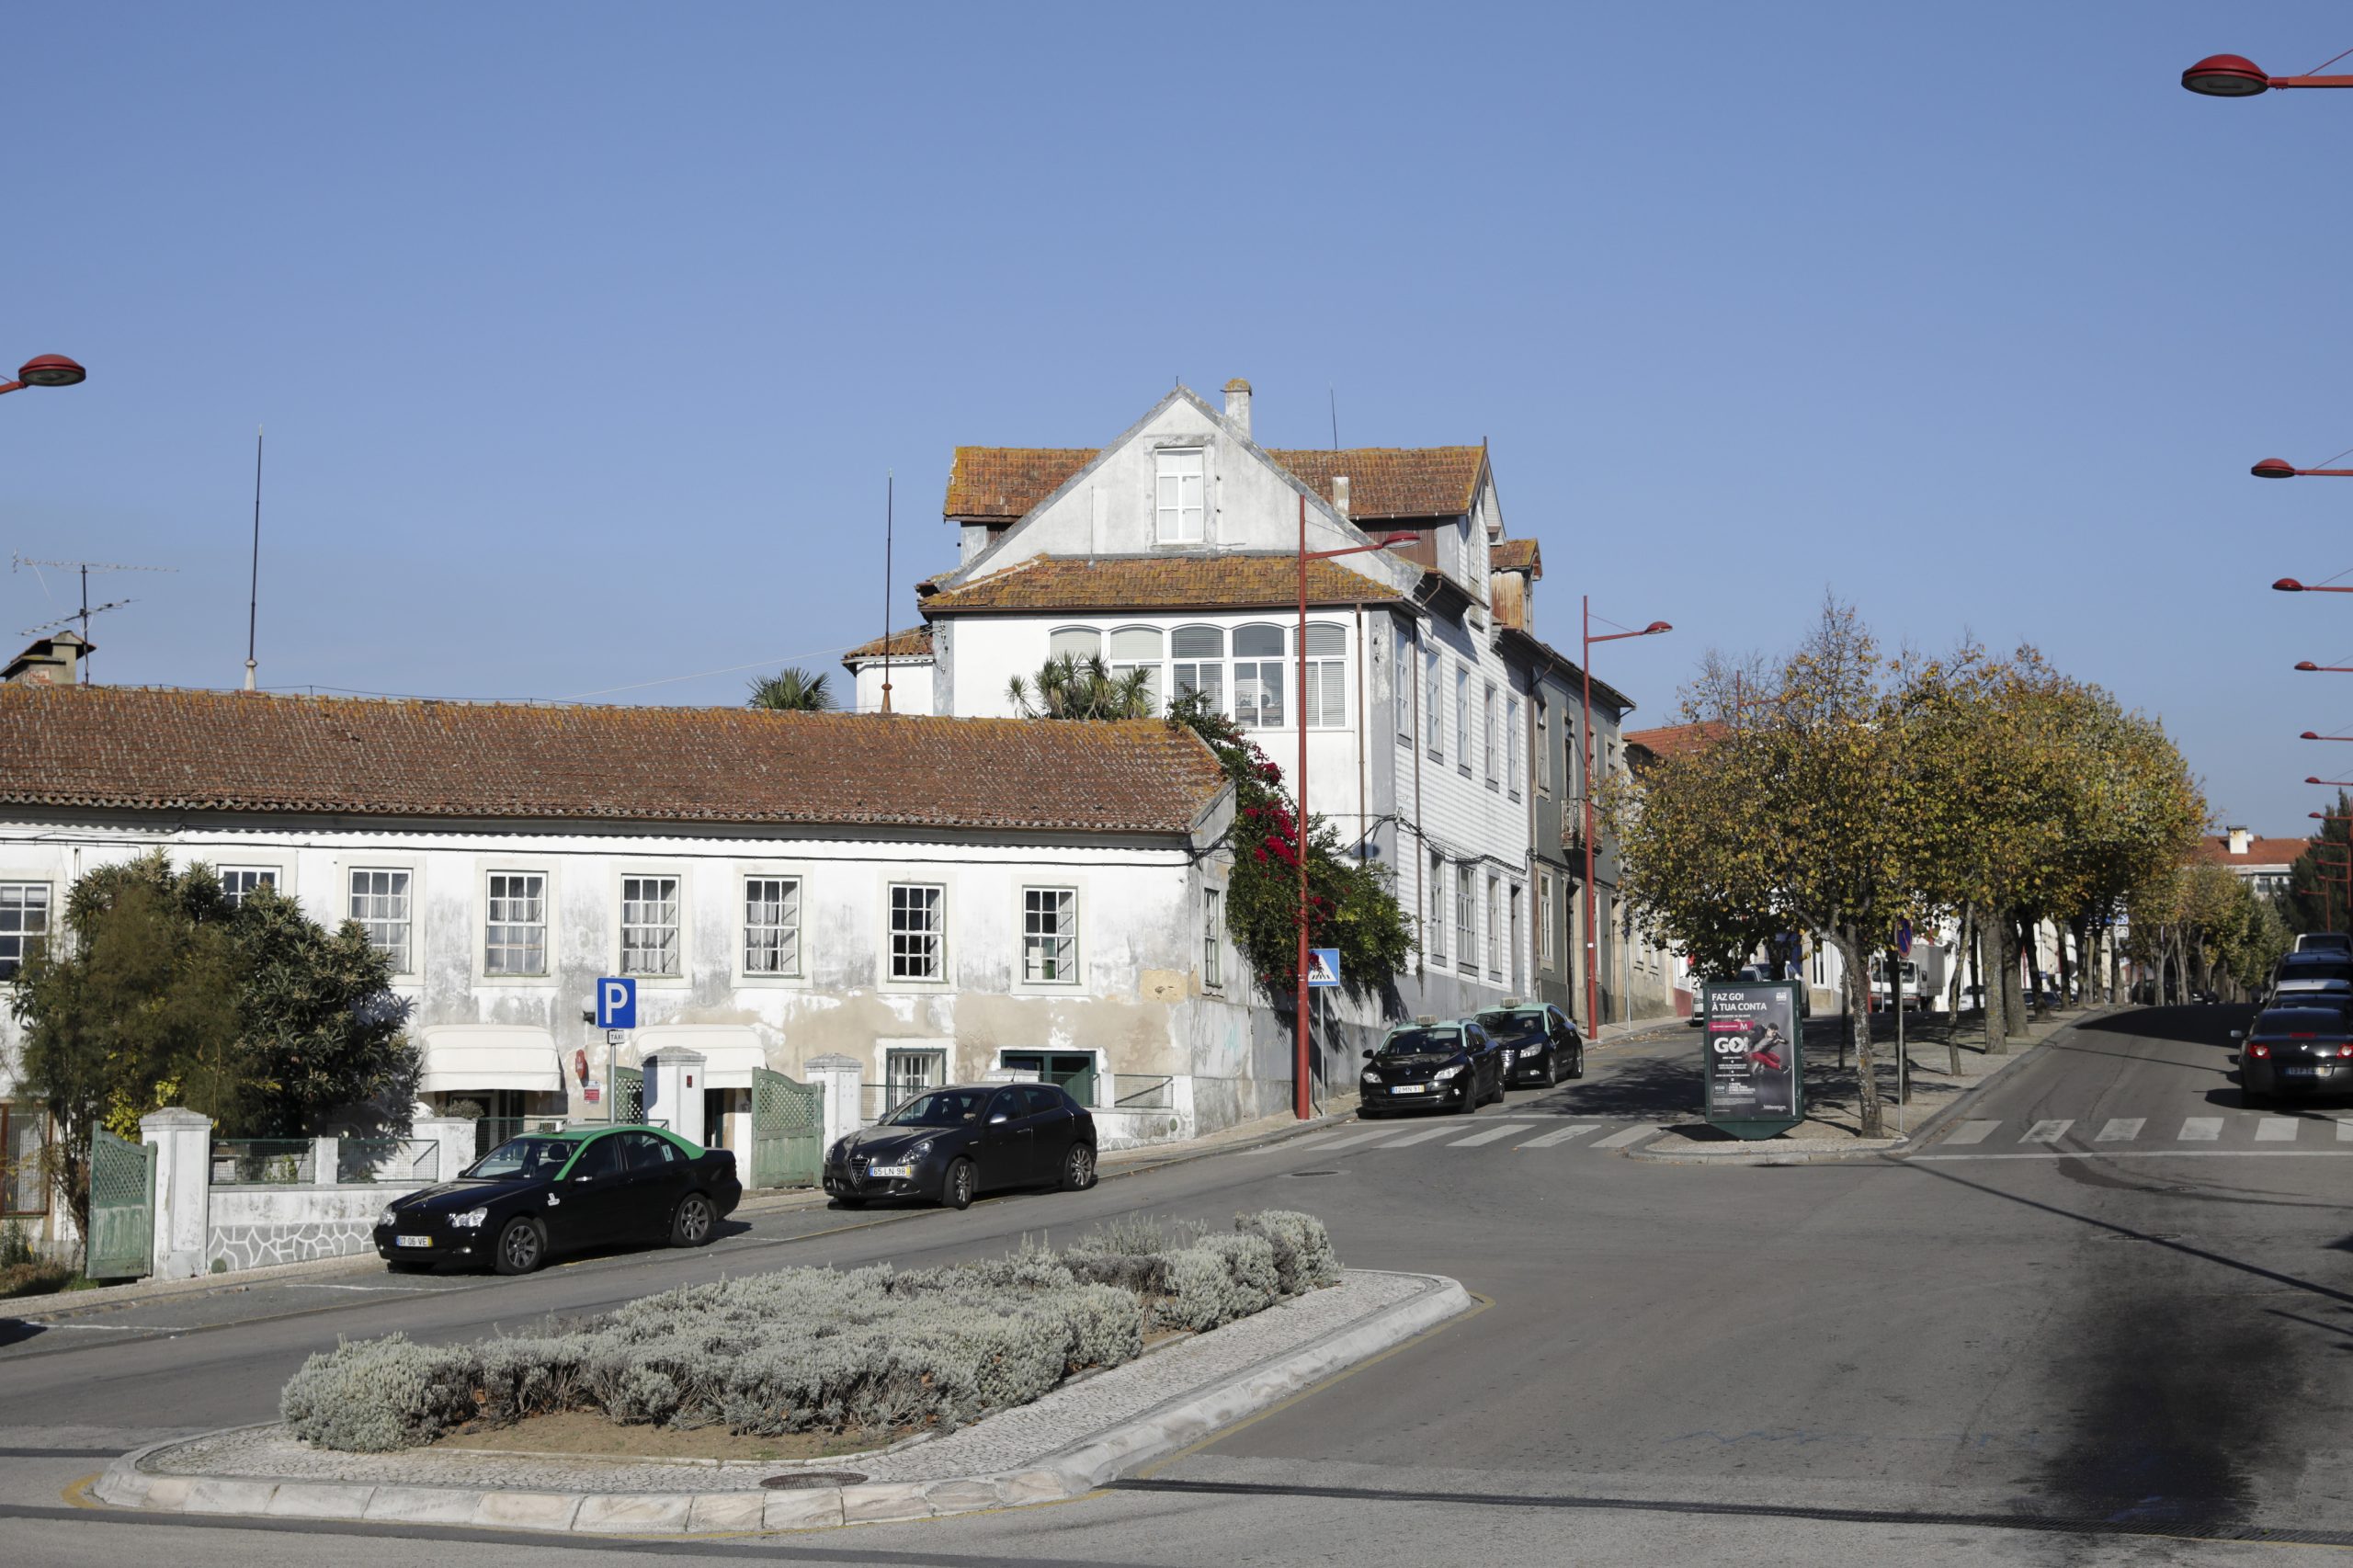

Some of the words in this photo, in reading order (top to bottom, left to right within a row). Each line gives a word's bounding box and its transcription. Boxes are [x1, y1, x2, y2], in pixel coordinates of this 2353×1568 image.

[1729, 993, 1745, 1001] GO!
[606, 983, 628, 1024] P
[1711, 1002, 1718, 1011] À
[1719, 1003, 1736, 1011] TUA
[1737, 1003, 1767, 1011] CONTA
[1714, 1037, 1749, 1053] GO!
[417, 1237, 427, 1245] VE
